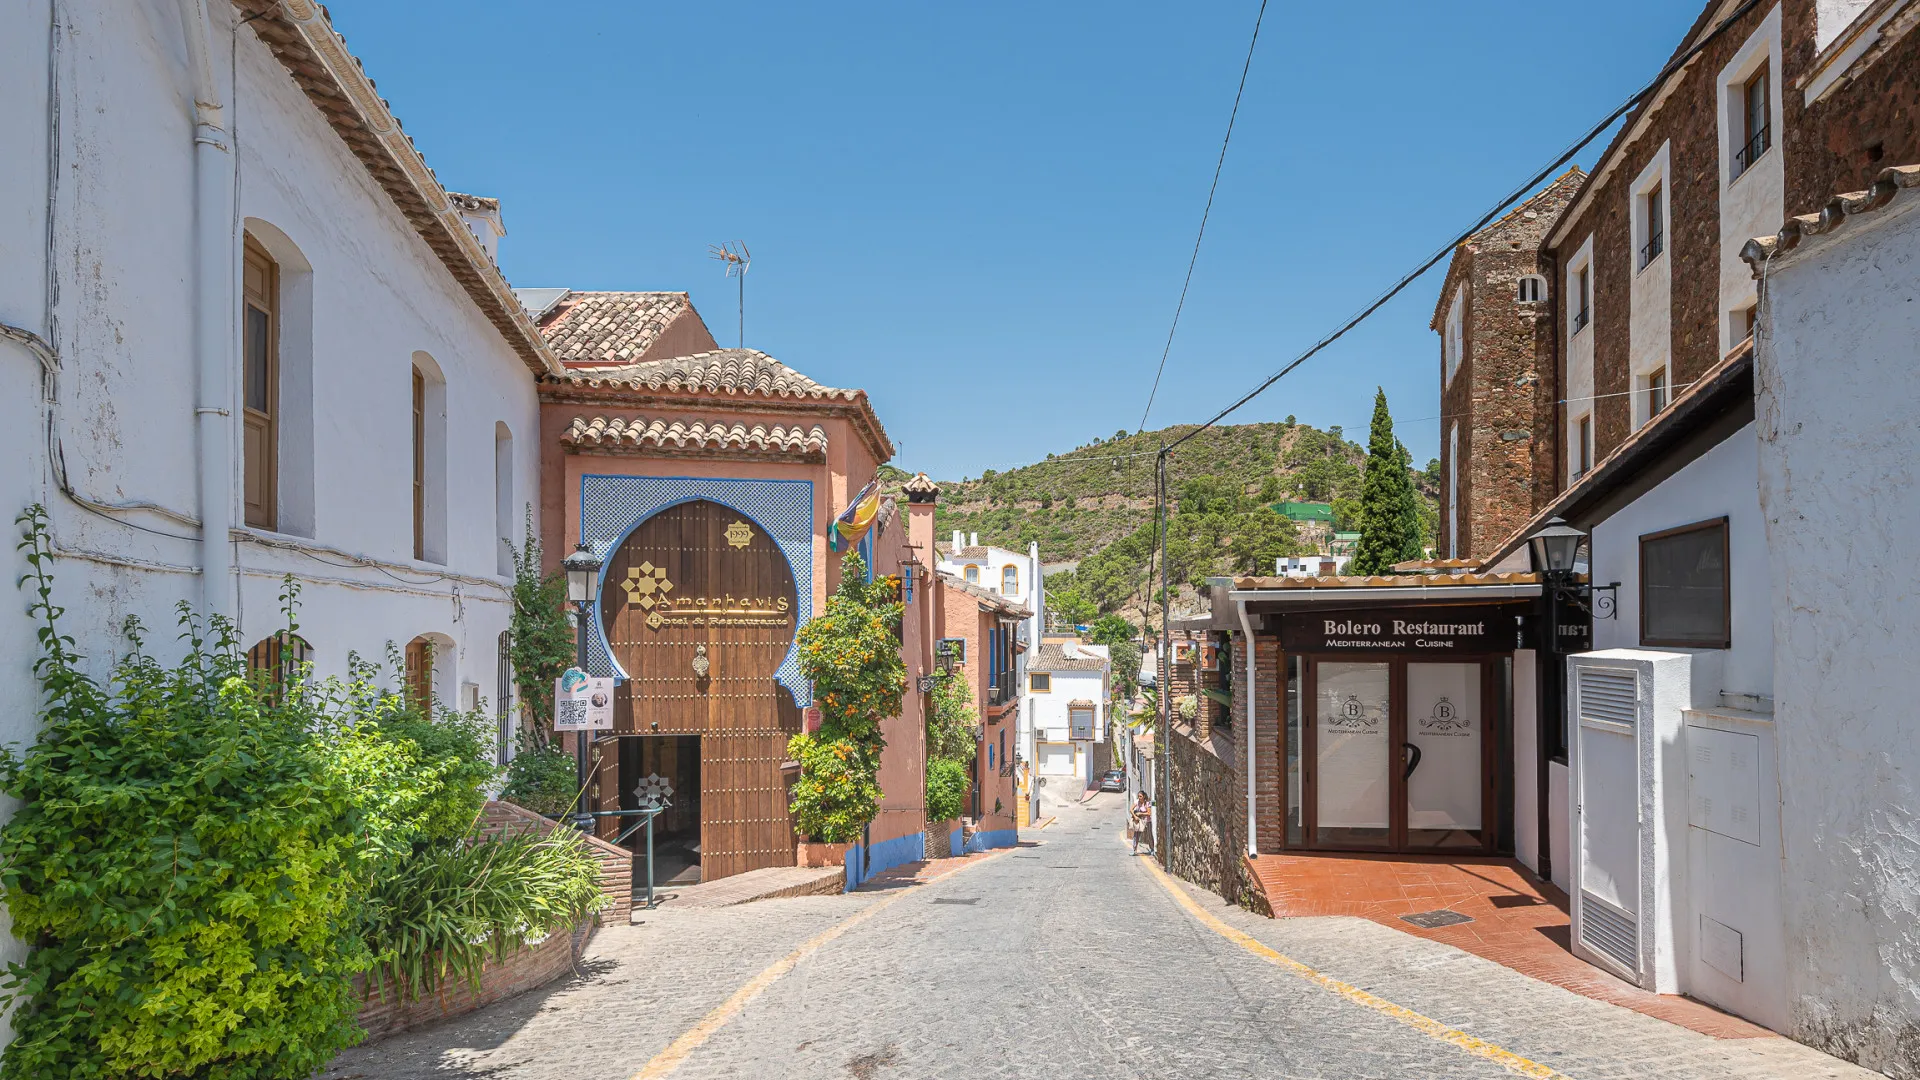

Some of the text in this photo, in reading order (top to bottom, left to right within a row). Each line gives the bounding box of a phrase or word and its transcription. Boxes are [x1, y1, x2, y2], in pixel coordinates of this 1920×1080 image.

[650, 616, 788, 625] Hotel & Restaurants
[1324, 620, 1484, 635] Bolero Restaurant
[1325, 638, 1453, 648] MEDITERRANEAN CUISINE
[1349, 704, 1359, 716] B
[1439, 706, 1450, 718] B
